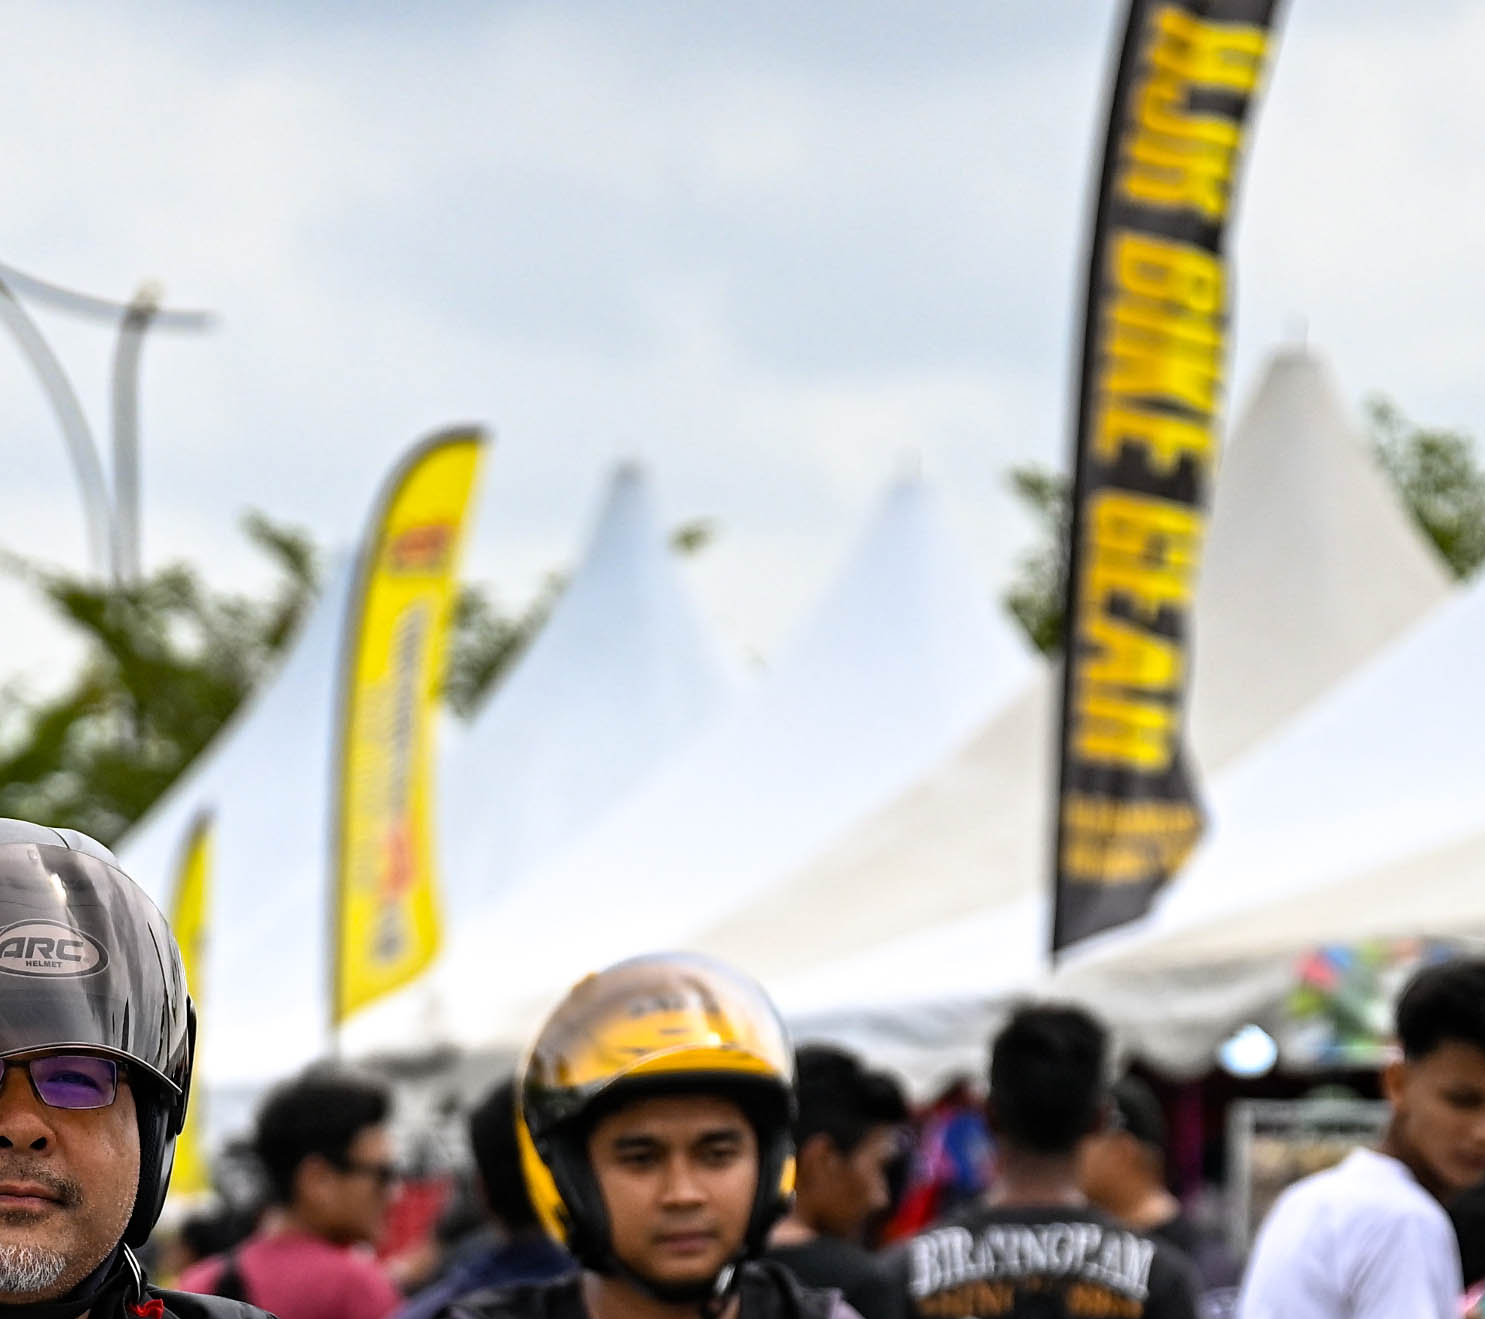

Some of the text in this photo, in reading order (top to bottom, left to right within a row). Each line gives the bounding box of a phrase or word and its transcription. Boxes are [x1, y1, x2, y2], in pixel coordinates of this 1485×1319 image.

[1096, 230, 1224, 477] BIKE
[1075, 492, 1202, 770] GEAR
[26, 960, 63, 969] HELMET
